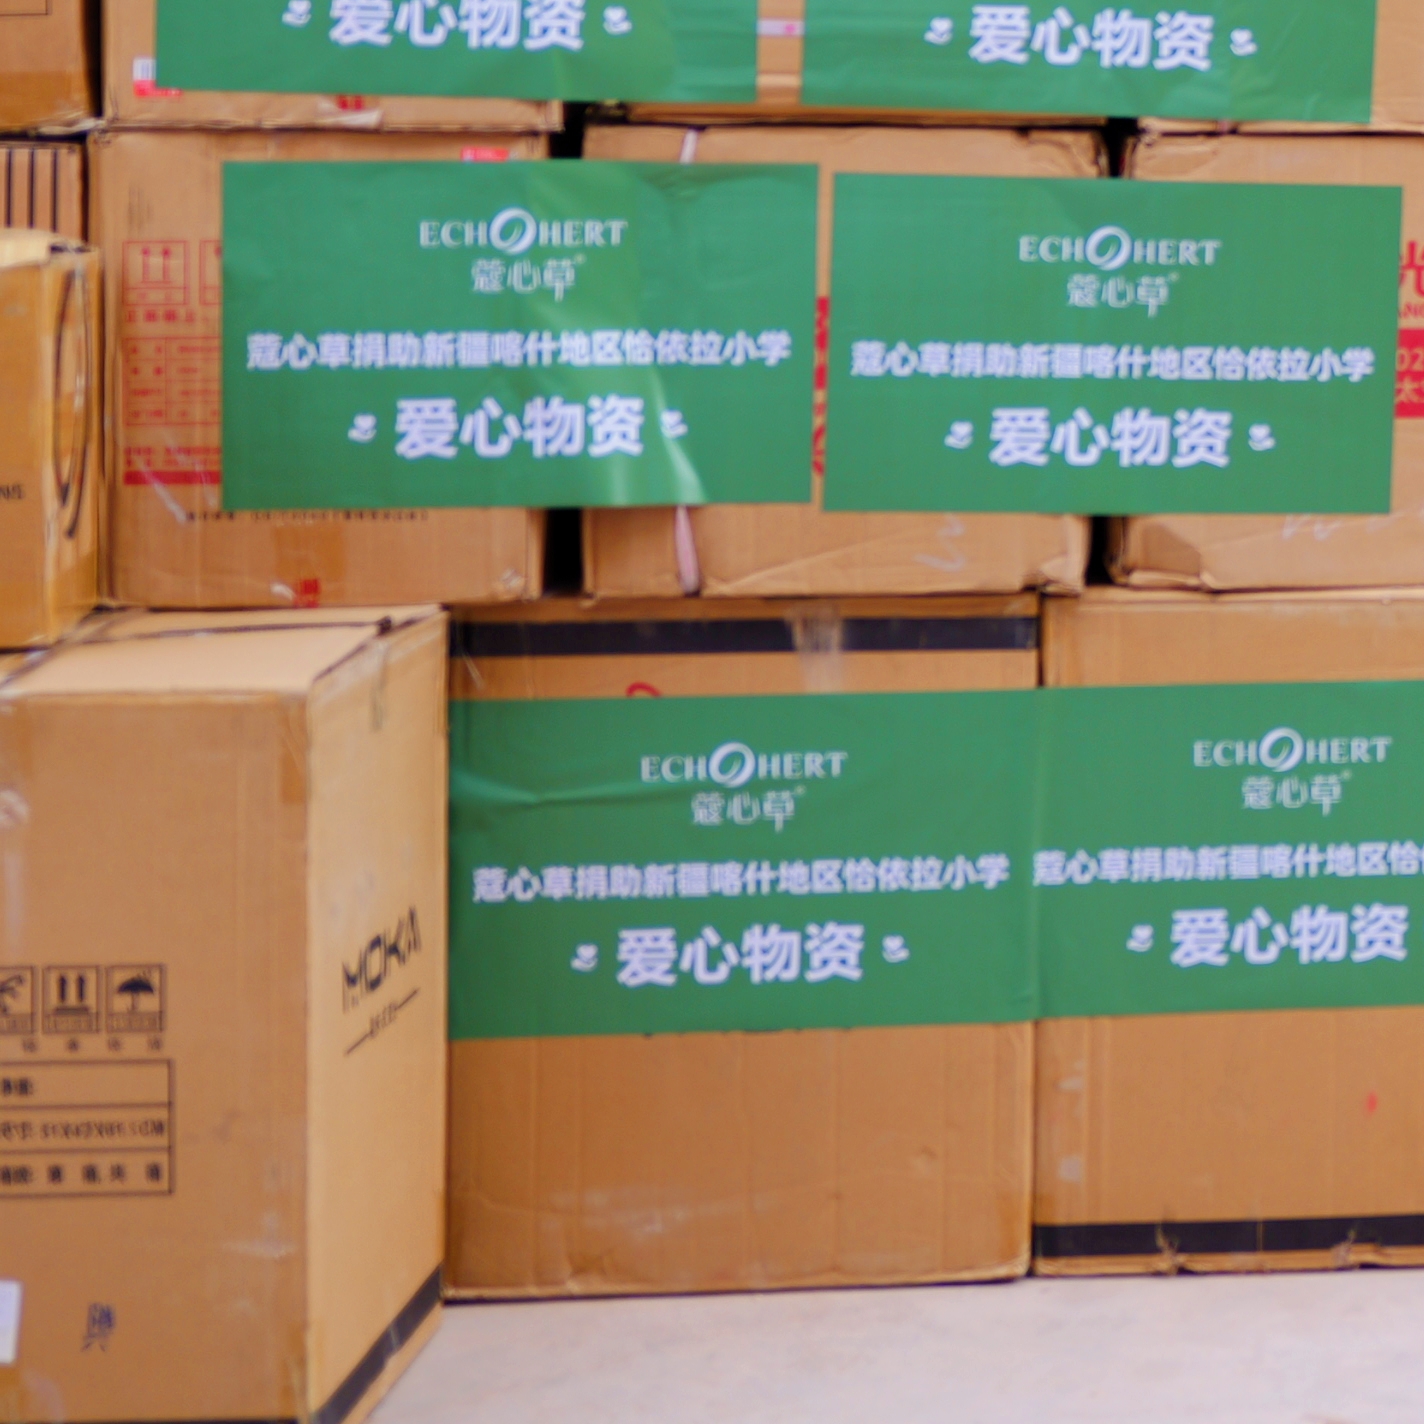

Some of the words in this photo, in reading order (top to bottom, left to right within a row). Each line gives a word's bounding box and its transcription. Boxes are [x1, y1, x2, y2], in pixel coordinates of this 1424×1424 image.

[969, 5, 1214, 72] 爱心物资
[420, 207, 628, 253] ECHOHERT
[1018, 225, 1221, 271] ECHOHERT
[394, 394, 645, 460] 爱心物资
[988, 406, 1232, 468] 爱心物资
[641, 741, 848, 786] ECHOHERT
[1193, 727, 1392, 772] ECHOHERT
[341, 905, 422, 1014] MOKA
[616, 923, 864, 987] 爱心物资
[1170, 902, 1410, 968] 爱心物资
